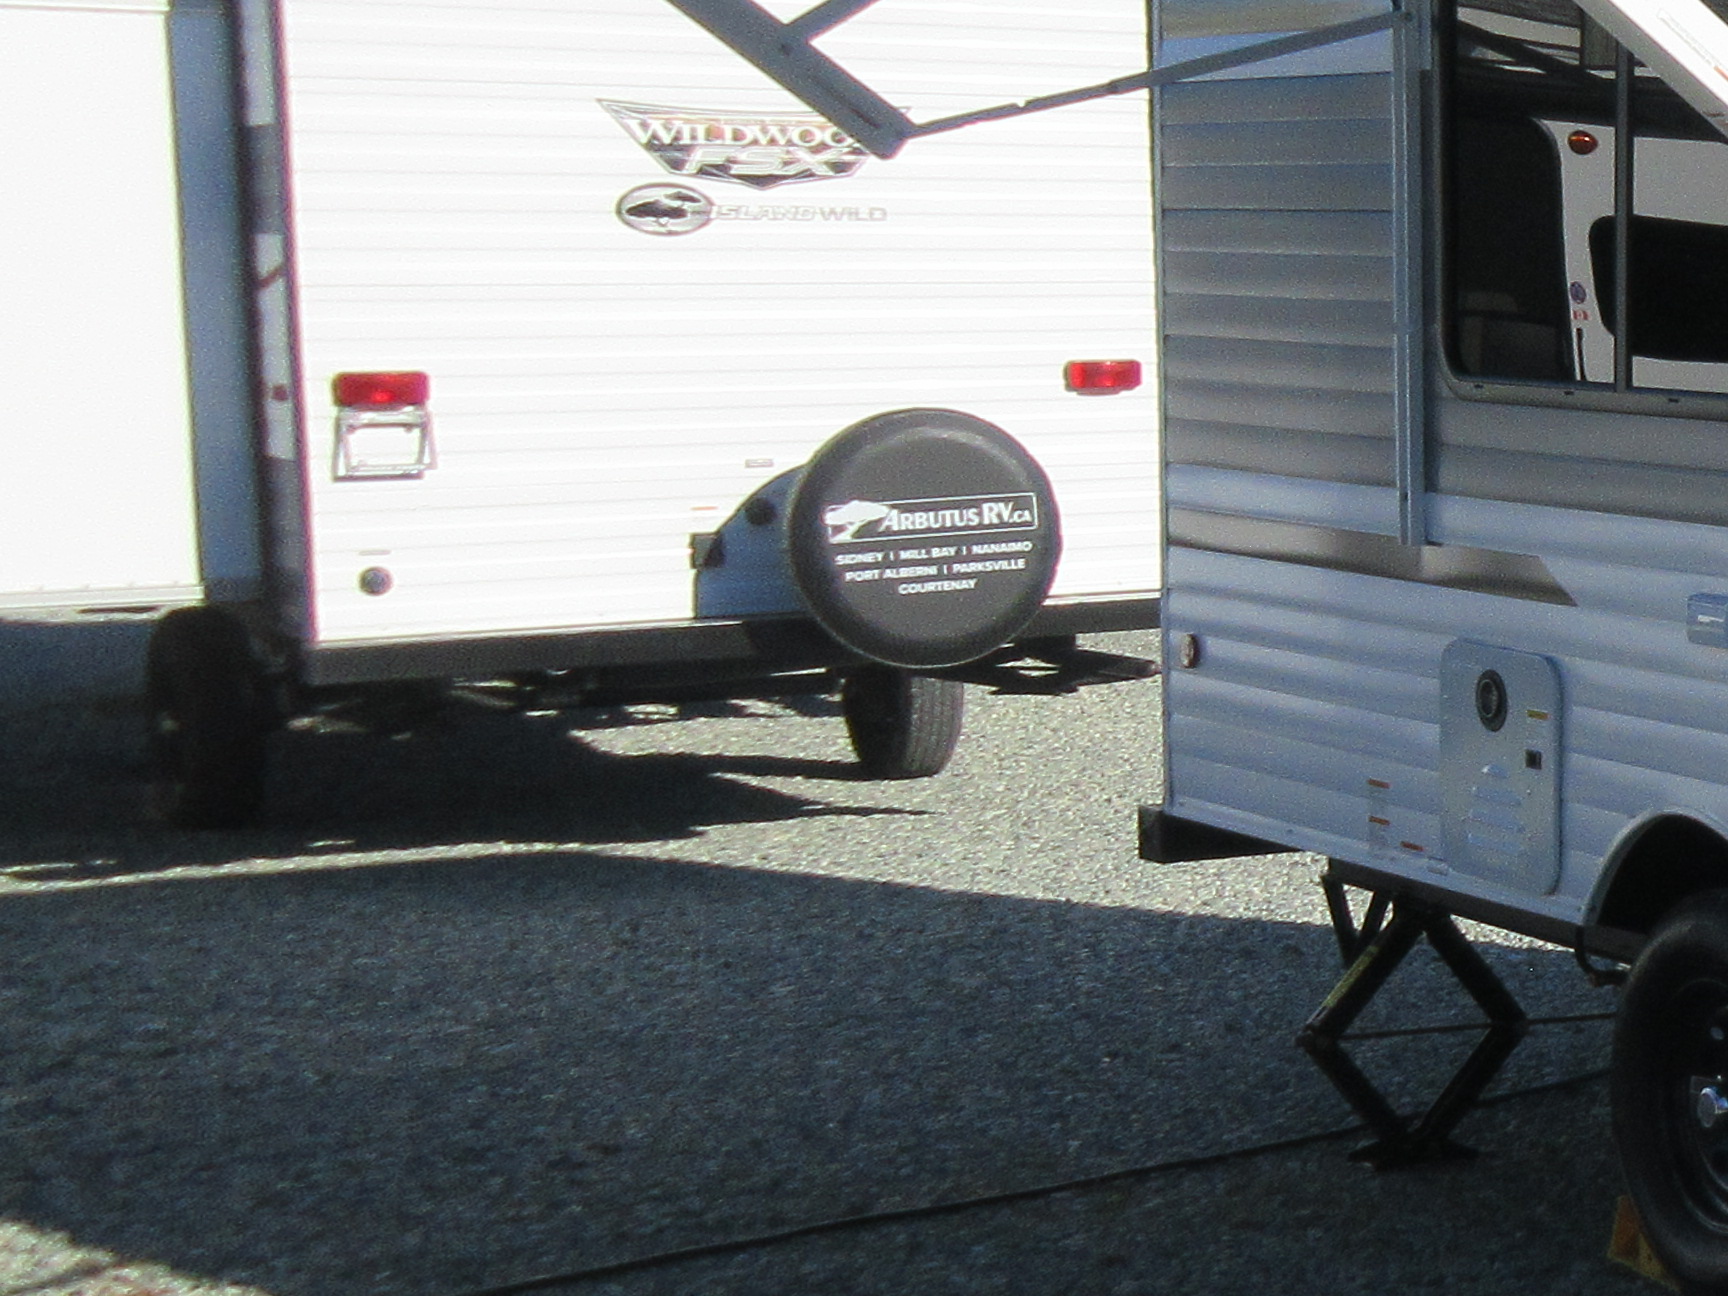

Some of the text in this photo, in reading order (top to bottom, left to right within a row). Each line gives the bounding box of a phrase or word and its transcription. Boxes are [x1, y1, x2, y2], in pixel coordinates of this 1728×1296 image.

[622, 118, 862, 146] WILDWOO
[682, 145, 857, 176] FSX
[711, 204, 888, 222] ISLAND WILD
[878, 508, 980, 533] ARBUTUS
[834, 551, 886, 566] SIDNEY
[899, 548, 930, 561] MILL
[931, 546, 958, 559] BAY
[971, 541, 1034, 554] NANAIMO
[844, 569, 881, 582] PORT
[882, 565, 939, 579] ALBERNI
[952, 558, 1027, 574] PARKSVILLE
[898, 578, 978, 595] COURTENAY
